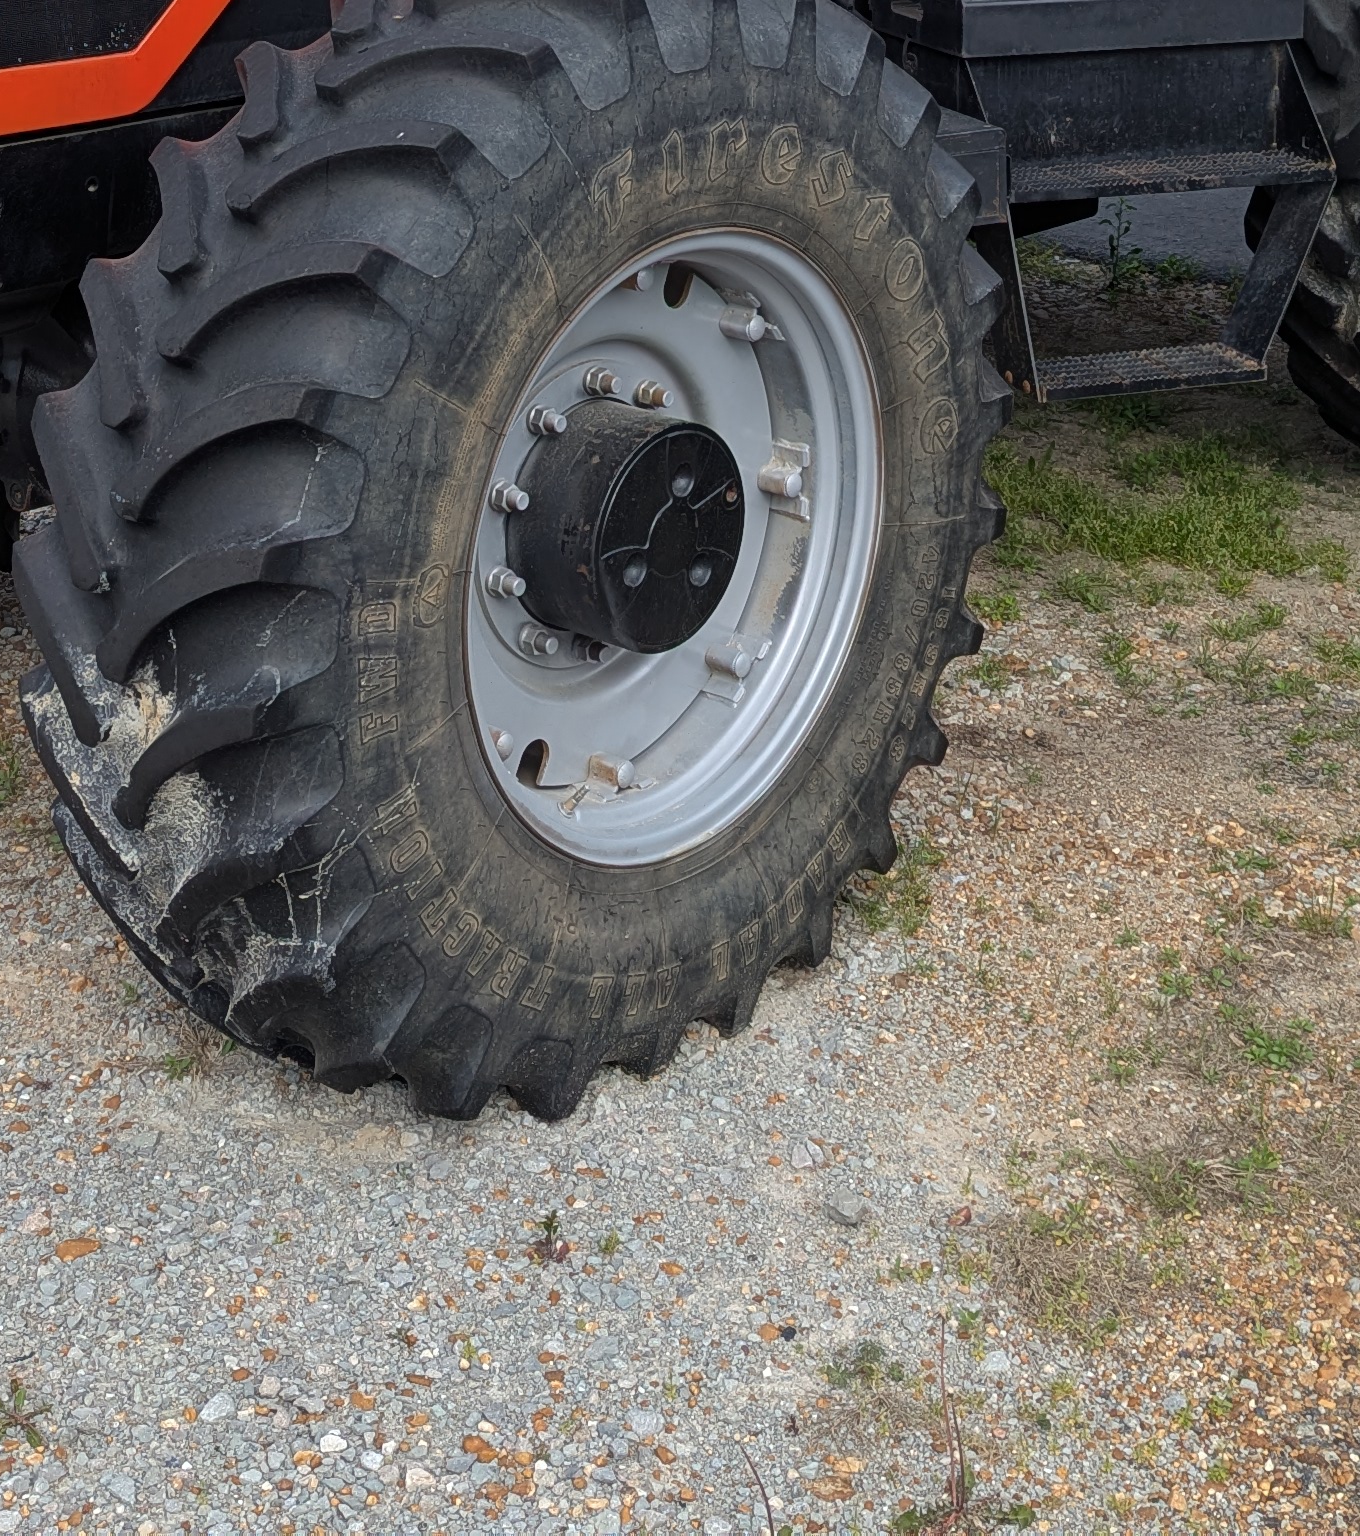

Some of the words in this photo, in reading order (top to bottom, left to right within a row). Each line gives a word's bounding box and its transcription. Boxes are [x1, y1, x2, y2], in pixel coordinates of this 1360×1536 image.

[592, 117, 959, 455] Firestone
[357, 601, 399, 745] FWD
[376, 784, 555, 1011] TRACTION
[710, 821, 852, 983] RADIAL
[588, 965, 683, 1020] ALL
